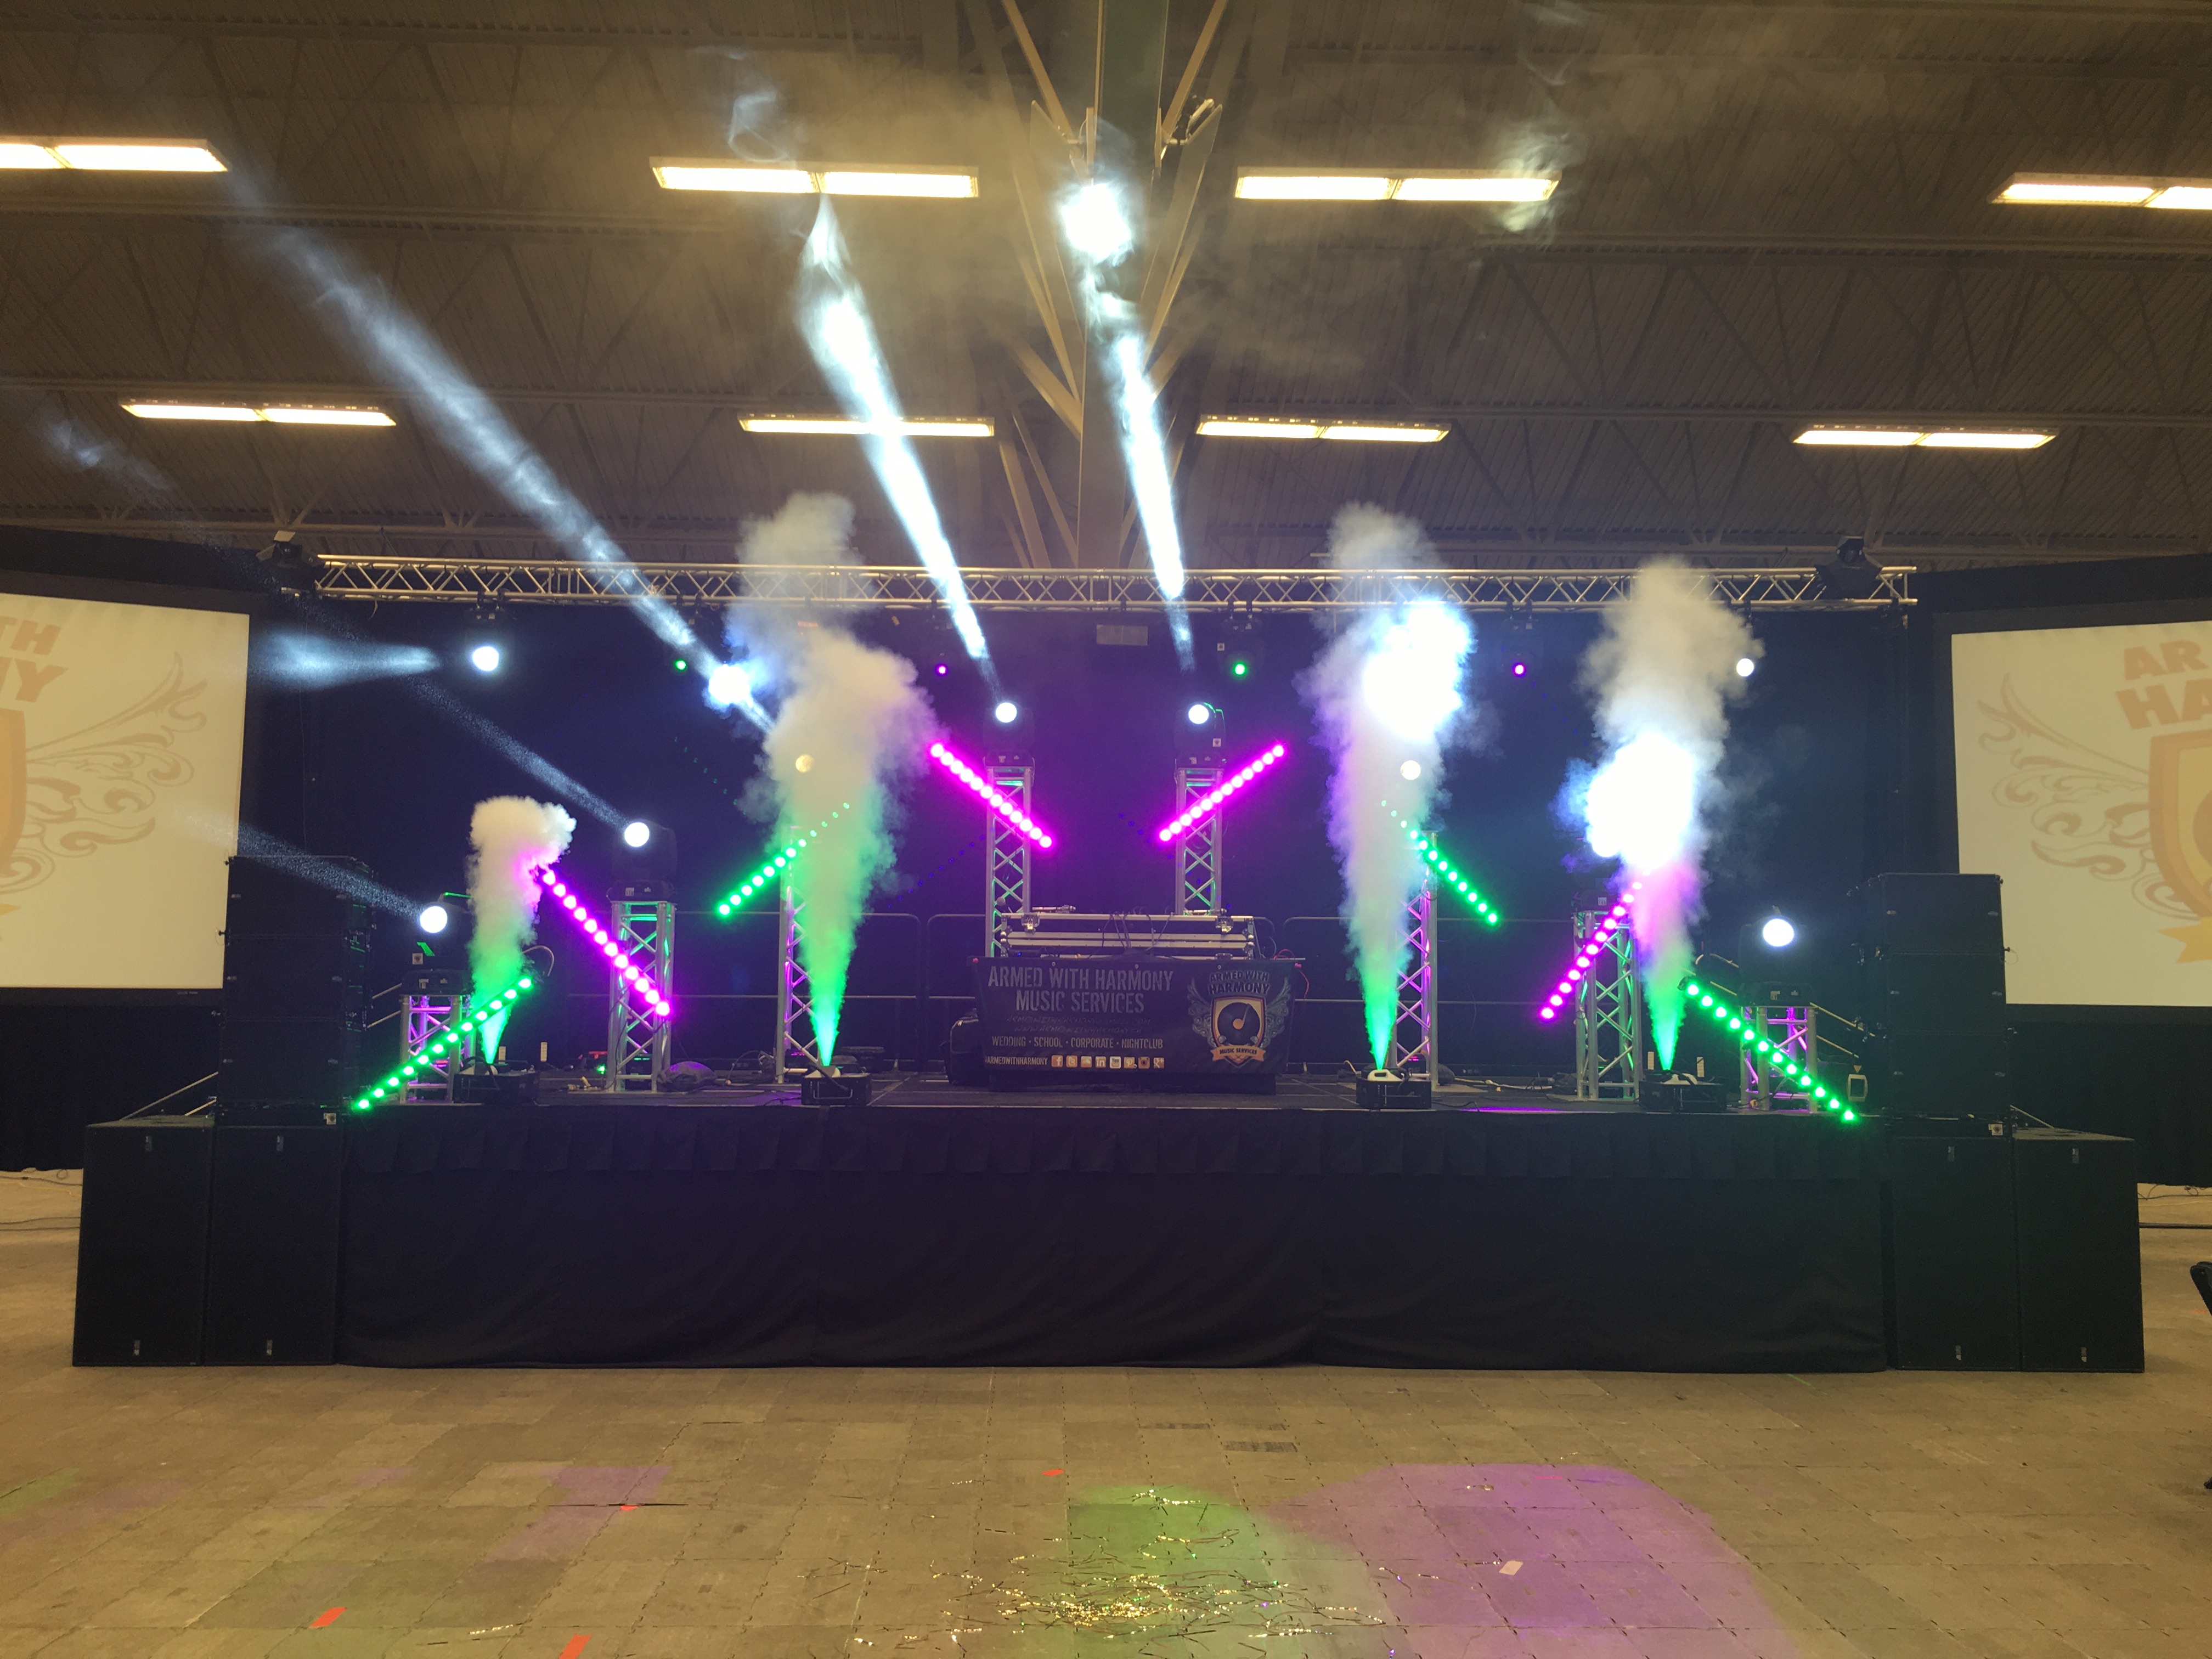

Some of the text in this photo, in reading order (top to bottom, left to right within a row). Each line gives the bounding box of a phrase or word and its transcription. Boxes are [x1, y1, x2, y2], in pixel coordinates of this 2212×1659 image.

[2124, 640, 2209, 681] AR
[0, 656, 70, 703] Y
[2115, 678, 2212, 729] HA
[988, 966, 1173, 991] ARMED WITH HARMONY
[1208, 981, 1271, 995] HARMONY
[1209, 970, 1269, 982] ARMED WITH
[1016, 990, 1144, 1013] MUSIC SERVICES
[992, 1036, 1164, 1049] WEDDING SCHOOL CORPORATE NIGHTCLUB
